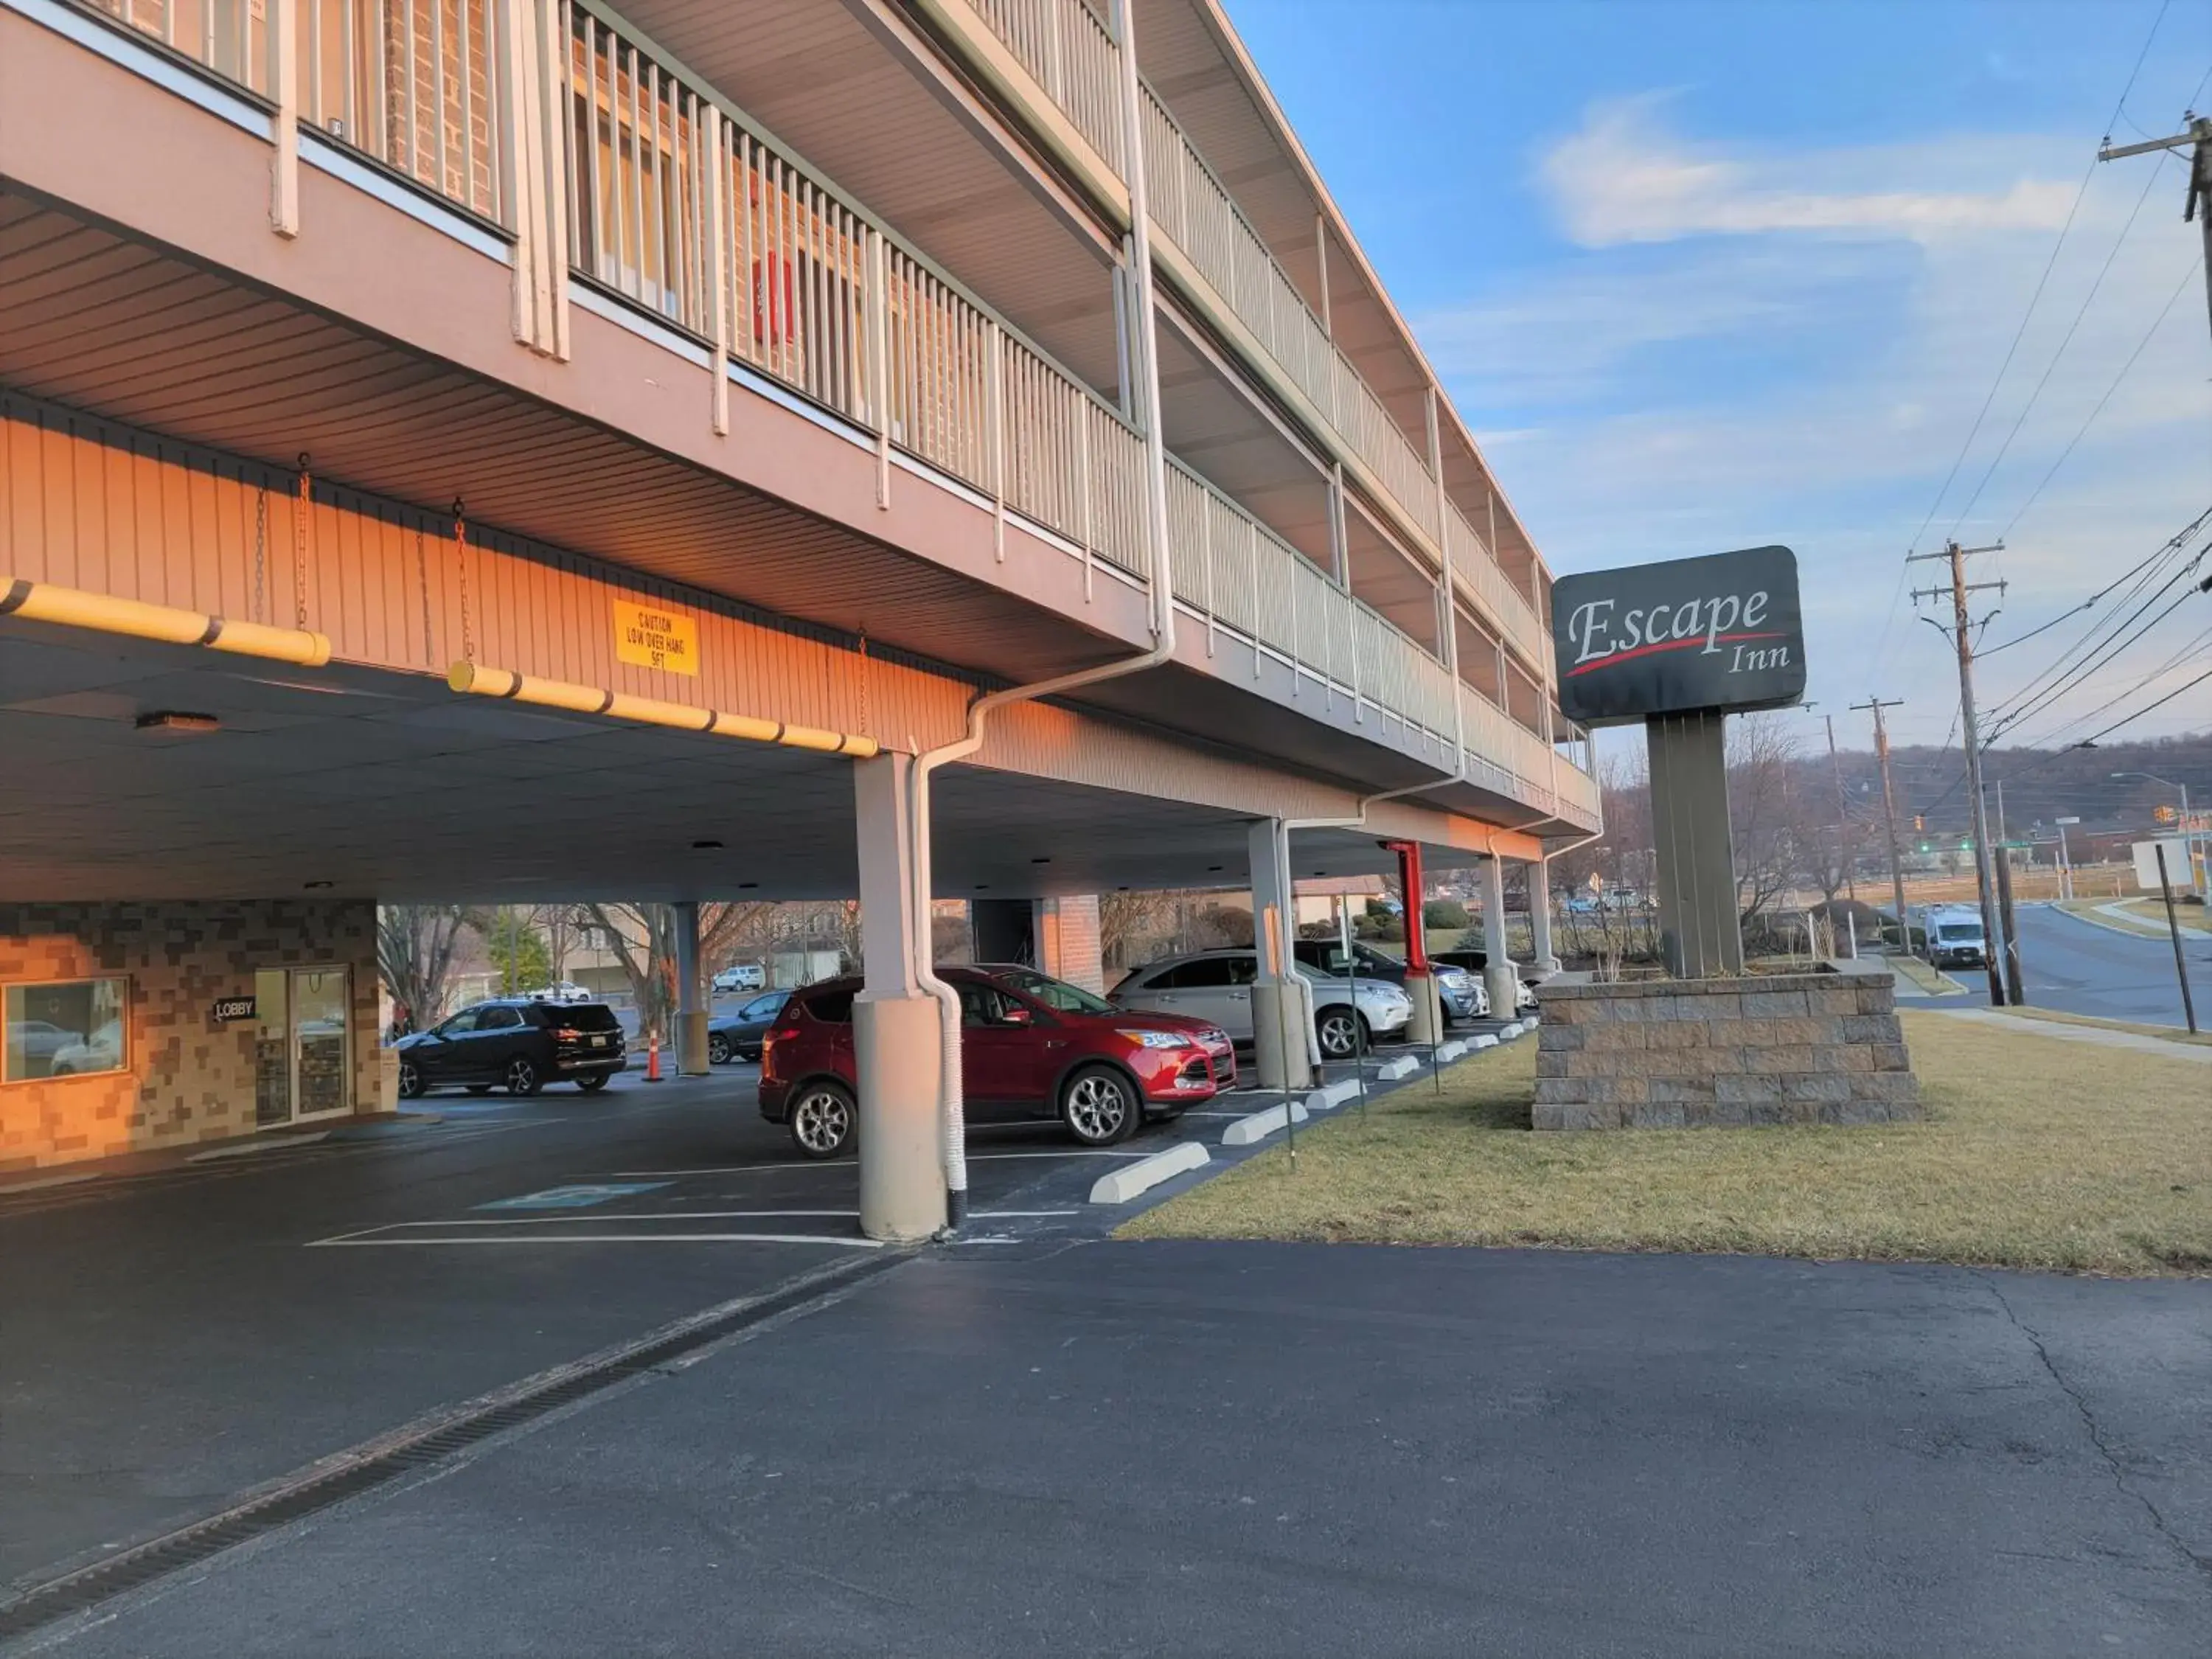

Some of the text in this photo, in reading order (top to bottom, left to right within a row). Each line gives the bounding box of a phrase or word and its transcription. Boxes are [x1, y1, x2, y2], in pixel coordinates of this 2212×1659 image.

[638, 611, 672, 633] CAUTION
[1568, 591, 1769, 664] Escape
[626, 626, 684, 655] LOW OVER HANG
[1728, 645, 1790, 673] Inn
[215, 1002, 253, 1018] LOBBY
